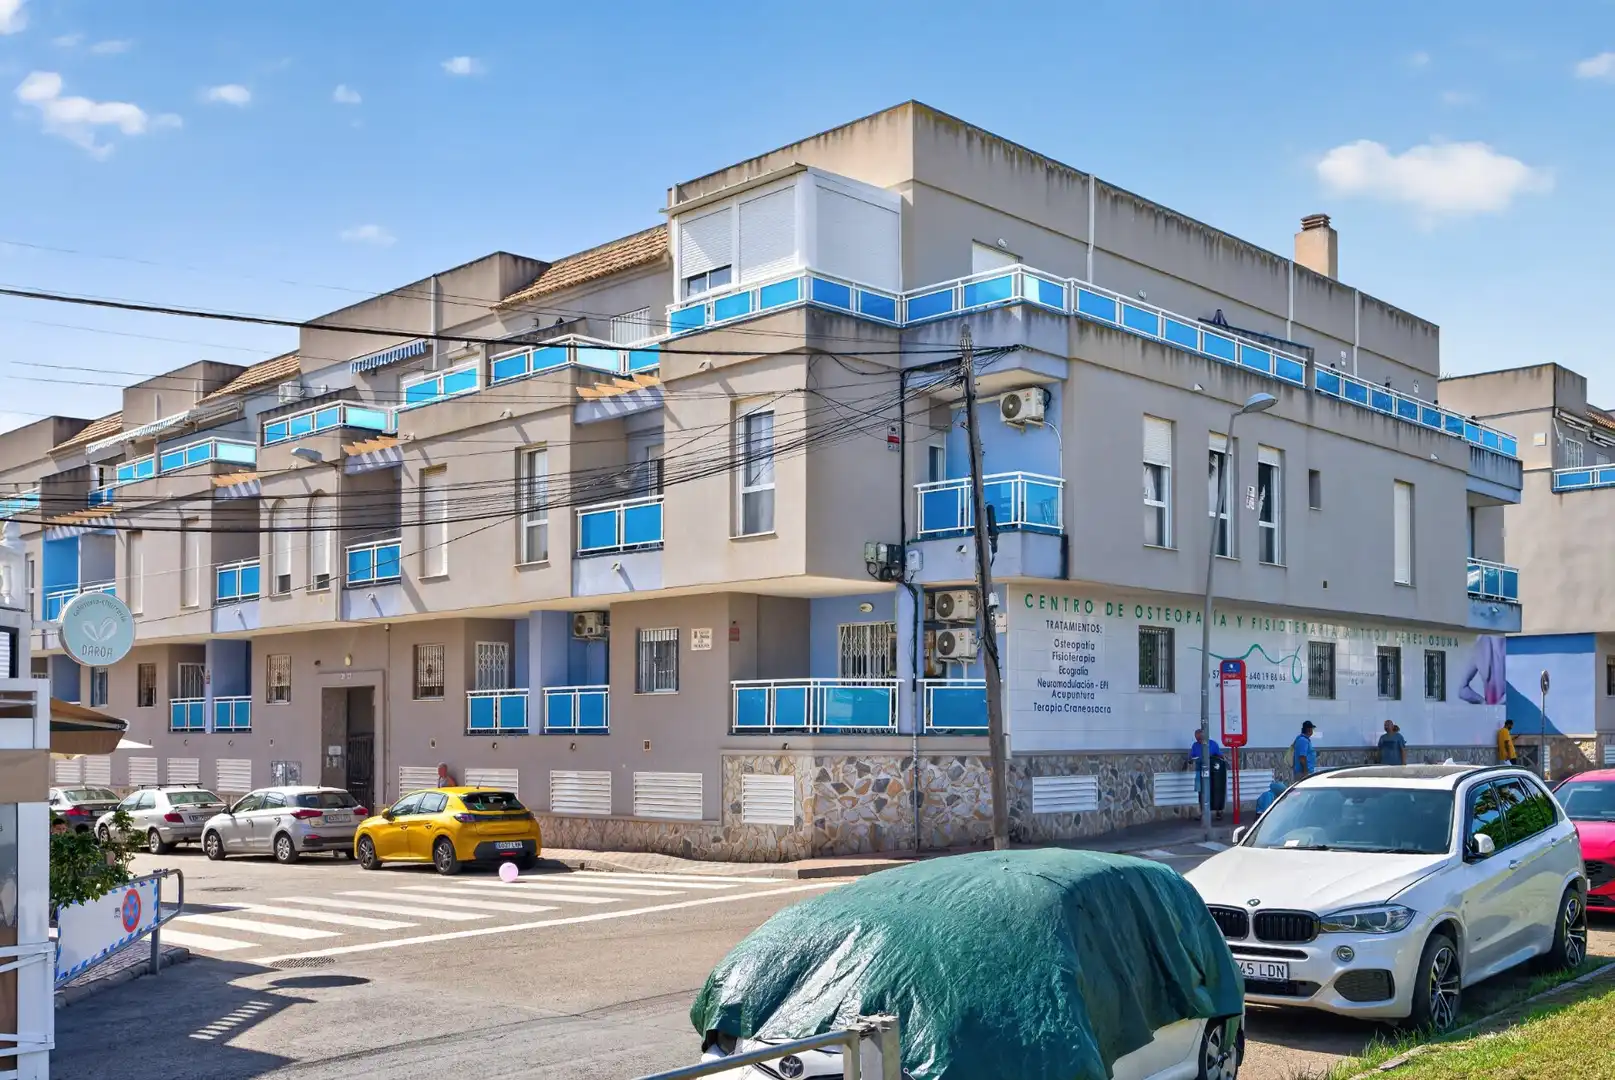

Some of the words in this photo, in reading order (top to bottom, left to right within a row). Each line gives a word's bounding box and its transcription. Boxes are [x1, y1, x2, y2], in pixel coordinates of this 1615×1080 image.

[1025, 593, 1094, 614] CENTRO
[1106, 602, 1123, 617] DE
[1135, 604, 1227, 627] OSTEOPAÍA
[1237, 615, 1244, 628] Y
[1046, 620, 1103, 633] TRATAMIENTOS:
[81, 645, 113, 658] DAROA
[1052, 652, 1096, 663] Fisioterapia
[1051, 689, 1095, 700] Acupuntura
[1033, 702, 1062, 713] Terapia
[1260, 964, 1284, 978] LDN
